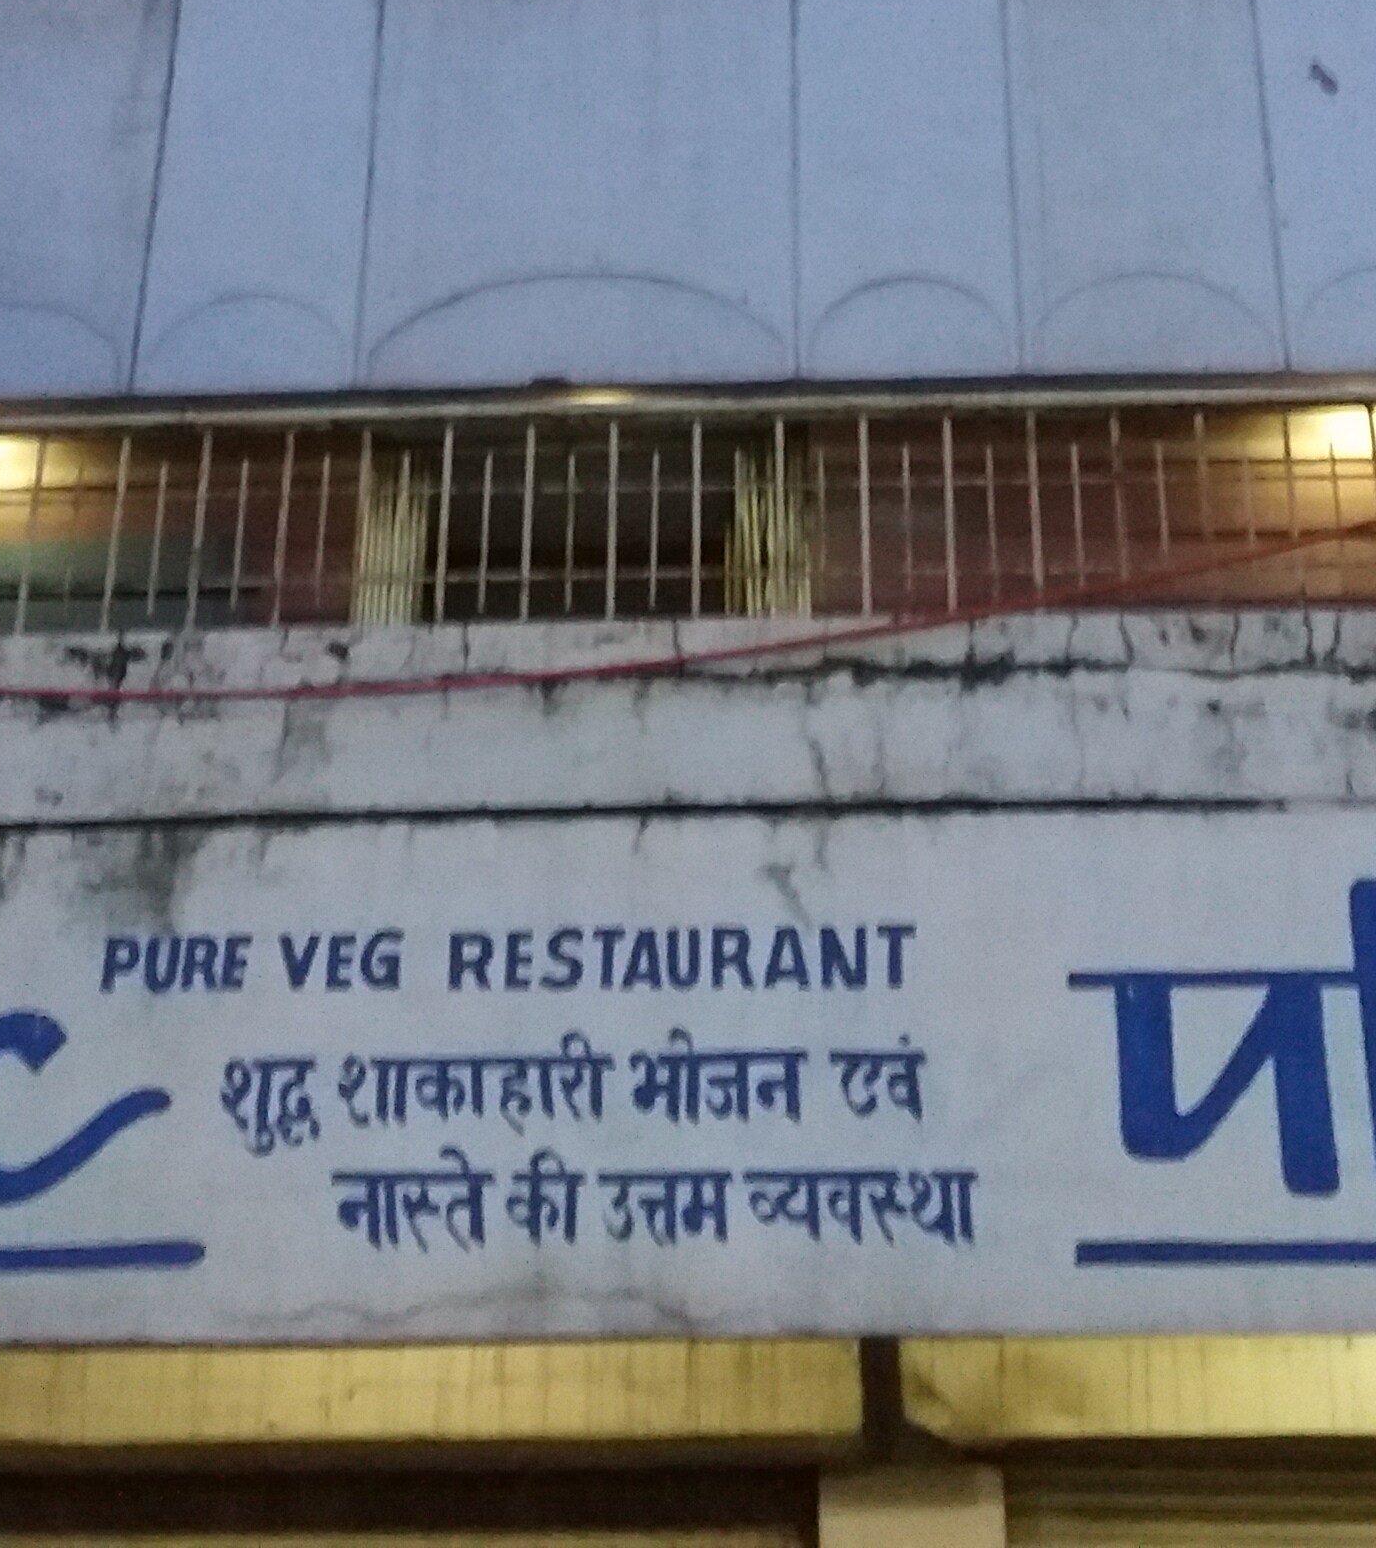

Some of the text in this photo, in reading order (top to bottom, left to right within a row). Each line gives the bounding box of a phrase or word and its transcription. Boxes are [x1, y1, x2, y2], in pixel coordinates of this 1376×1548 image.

[99, 924, 916, 993] PURE VEG RESTAURANT
[338, 1031, 616, 1134] शाकाहारी
[628, 1028, 808, 1124] भोजन
[828, 1034, 926, 1122] एवं
[331, 1145, 978, 1251] नास्ते की उत्तम व्यवस्था
